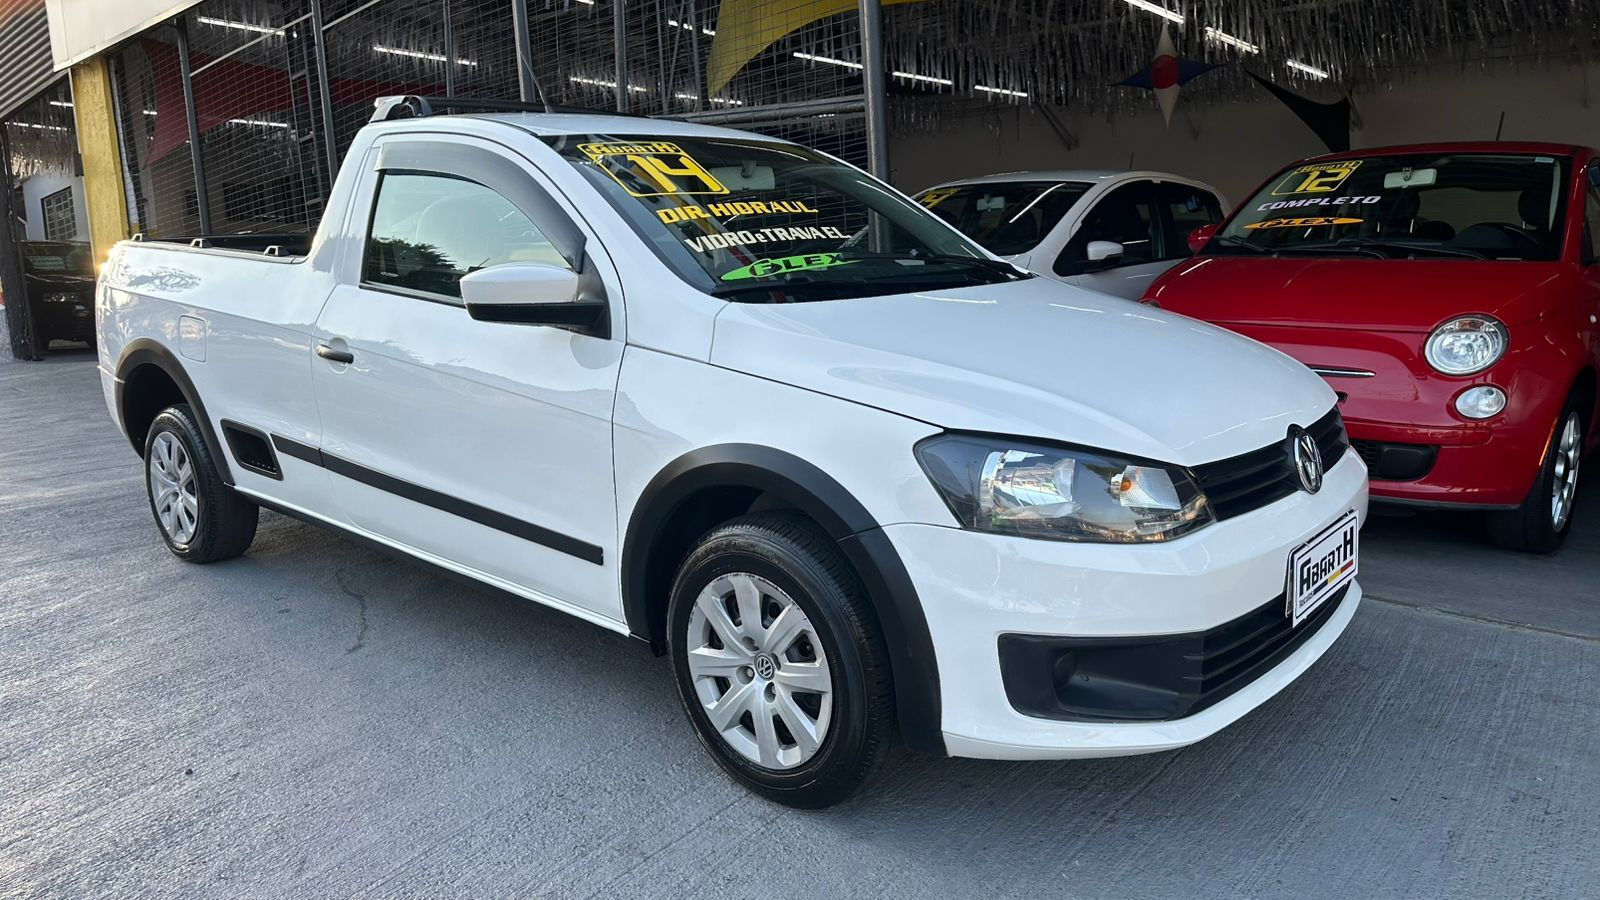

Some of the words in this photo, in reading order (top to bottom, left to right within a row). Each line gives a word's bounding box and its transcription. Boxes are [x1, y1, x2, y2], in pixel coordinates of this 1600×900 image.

[626, 154, 722, 193] 14
[1295, 168, 1352, 192] 12
[656, 206, 712, 224] DIR.
[1257, 195, 1381, 211] COMPLETO
[1258, 217, 1335, 228] FLEX
[751, 253, 846, 277] FLEX
[1299, 525, 1354, 597] ABARTH
